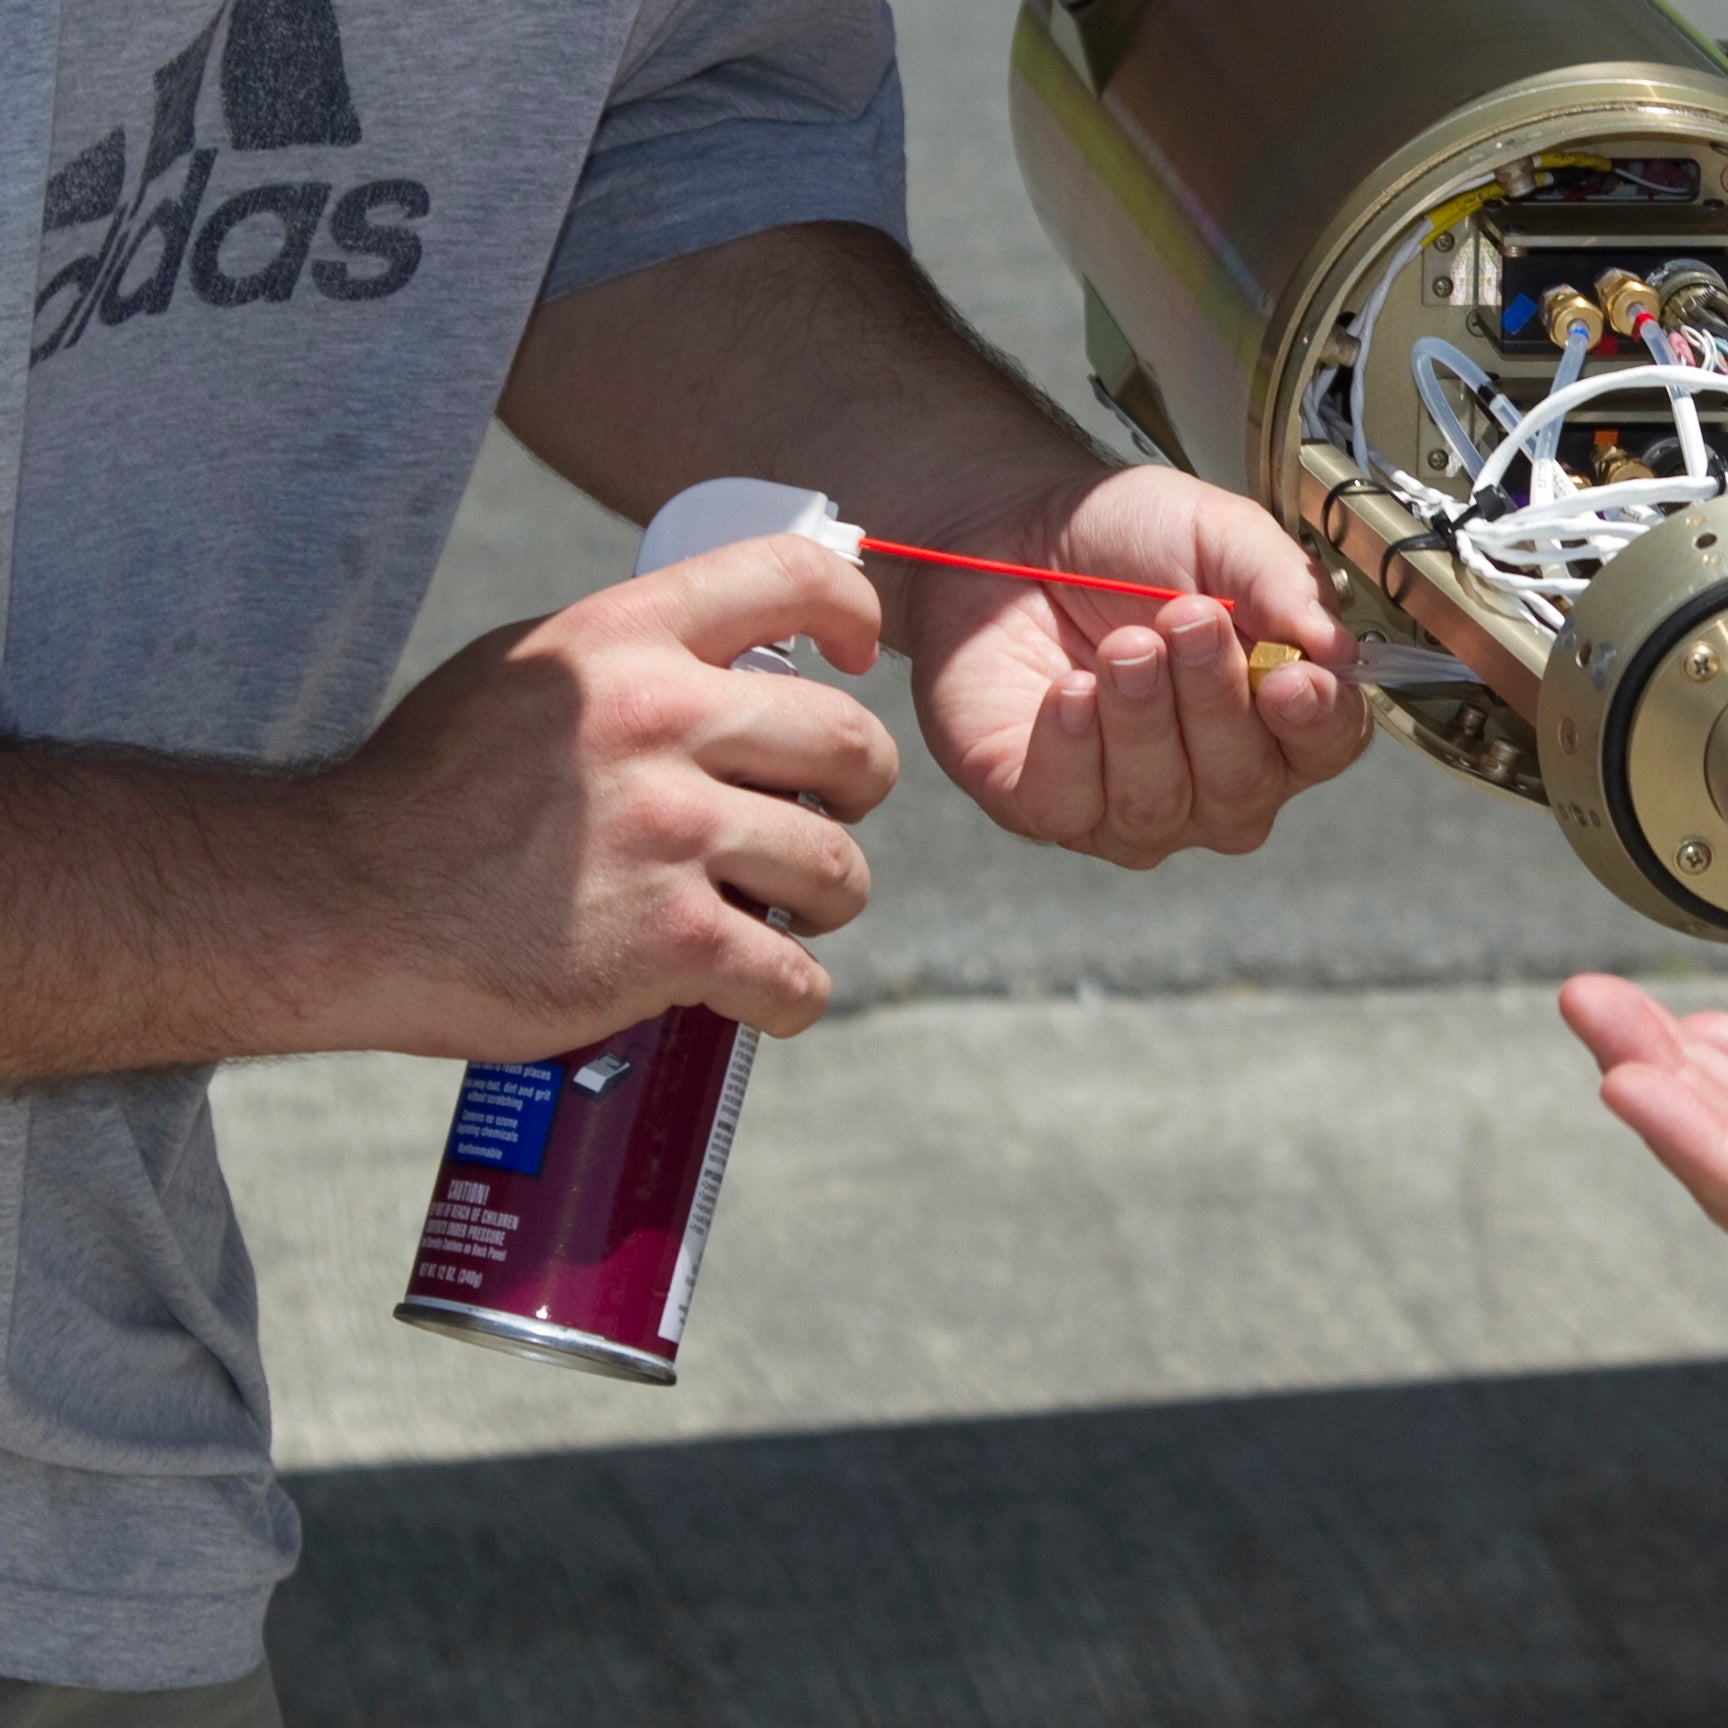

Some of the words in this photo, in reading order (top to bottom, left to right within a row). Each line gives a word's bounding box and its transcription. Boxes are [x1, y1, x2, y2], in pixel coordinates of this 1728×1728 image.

[30, 148, 431, 369] didas
[523, 1065, 552, 1081] places
[503, 1082, 518, 1094] dirt
[518, 1085, 534, 1098] and
[535, 1090, 551, 1102] grit
[495, 1115, 518, 1128] ozone
[481, 1126, 518, 1143] chemicals
[447, 1179, 490, 1205] CAUTION!
[470, 1206, 481, 1223] OF
[481, 1209, 520, 1231] CHILDREN
[467, 1225, 506, 1246] PRESSURE
[472, 1244, 487, 1257] Back
[488, 1247, 507, 1262] Panel
[457, 1268, 483, 1289] (340g)
